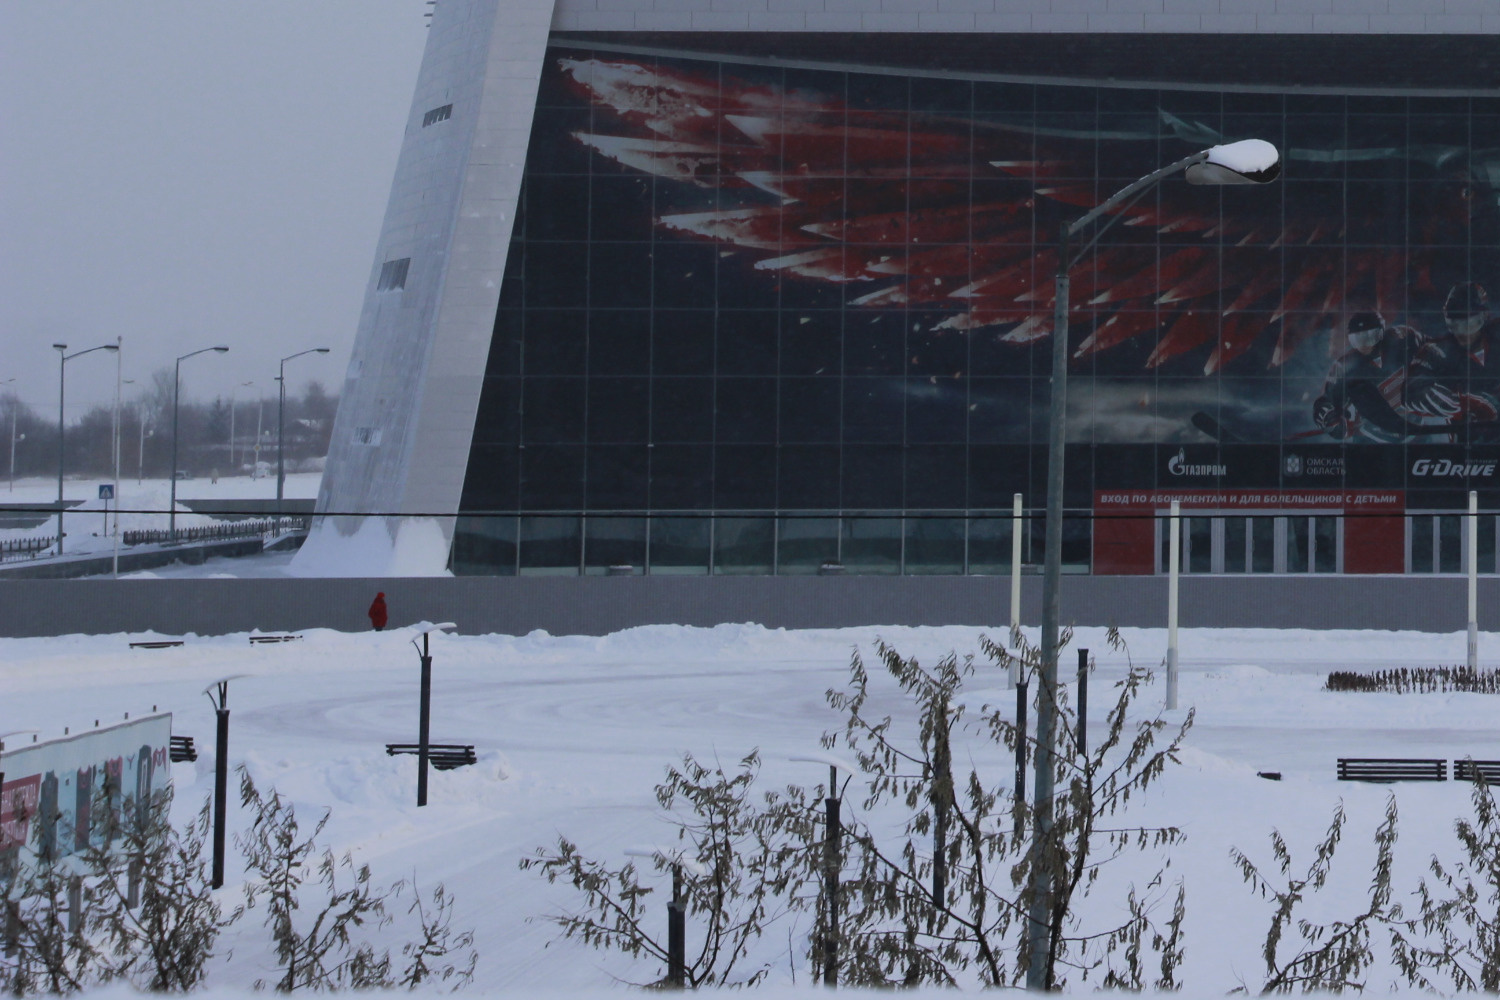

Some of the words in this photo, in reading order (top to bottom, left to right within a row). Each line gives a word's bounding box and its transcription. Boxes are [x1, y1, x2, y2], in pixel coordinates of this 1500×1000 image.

[1306, 457, 1345, 466] ОМСКАЯ
[1185, 464, 1227, 476] ГАЗПРОМ
[1306, 466, 1347, 476] ОБЛАСТЬ
[1100, 494, 1129, 504] ВХОД
[1132, 494, 1147, 503] ПО
[1149, 494, 1227, 503] АБОНЕМЕНТАМ
[1229, 494, 1237, 503] И
[1239, 494, 1261, 505] ДЛЯ
[1263, 494, 1343, 504] БОЛЕЛЬЩИКОВ
[1345, 494, 1353, 503] С
[1354, 494, 1397, 504] ДЕТЬМИ
